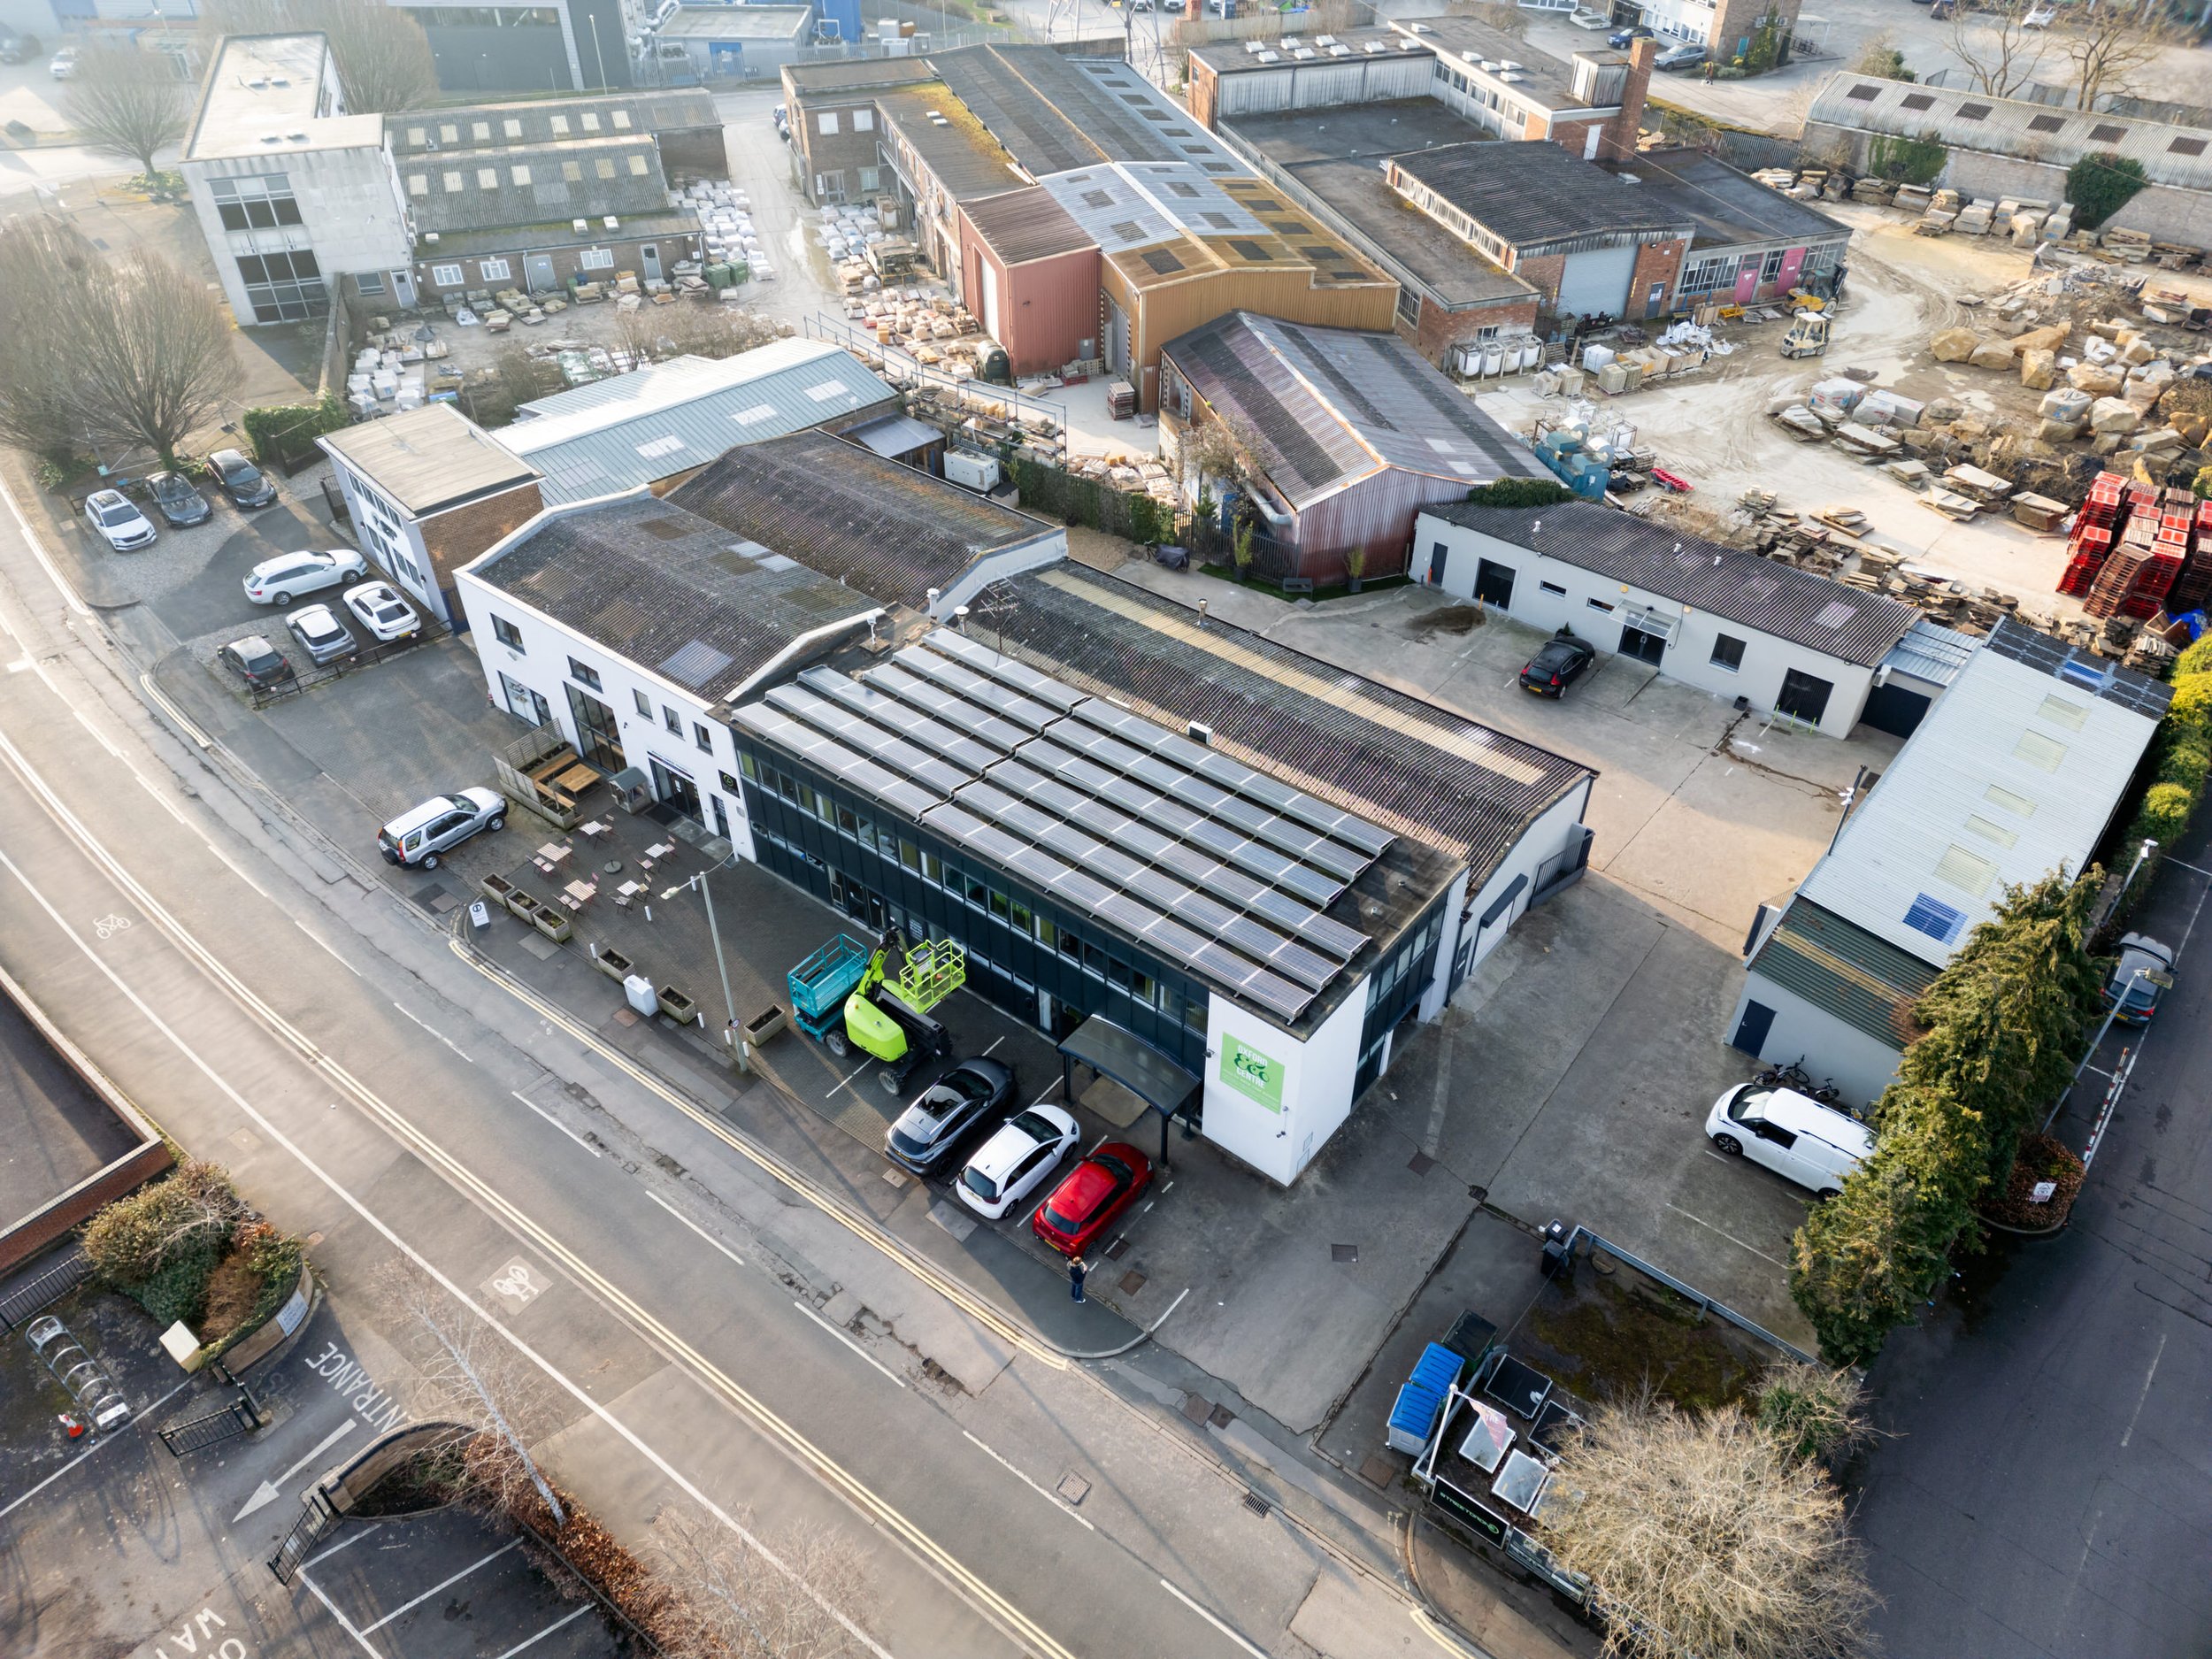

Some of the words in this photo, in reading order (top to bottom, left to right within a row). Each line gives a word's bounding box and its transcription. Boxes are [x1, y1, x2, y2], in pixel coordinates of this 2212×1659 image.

[1238, 1044, 1268, 1067] OXFORD
[1236, 1066, 1266, 1089] CENTRE
[304, 1341, 413, 1433] NTRANCE
